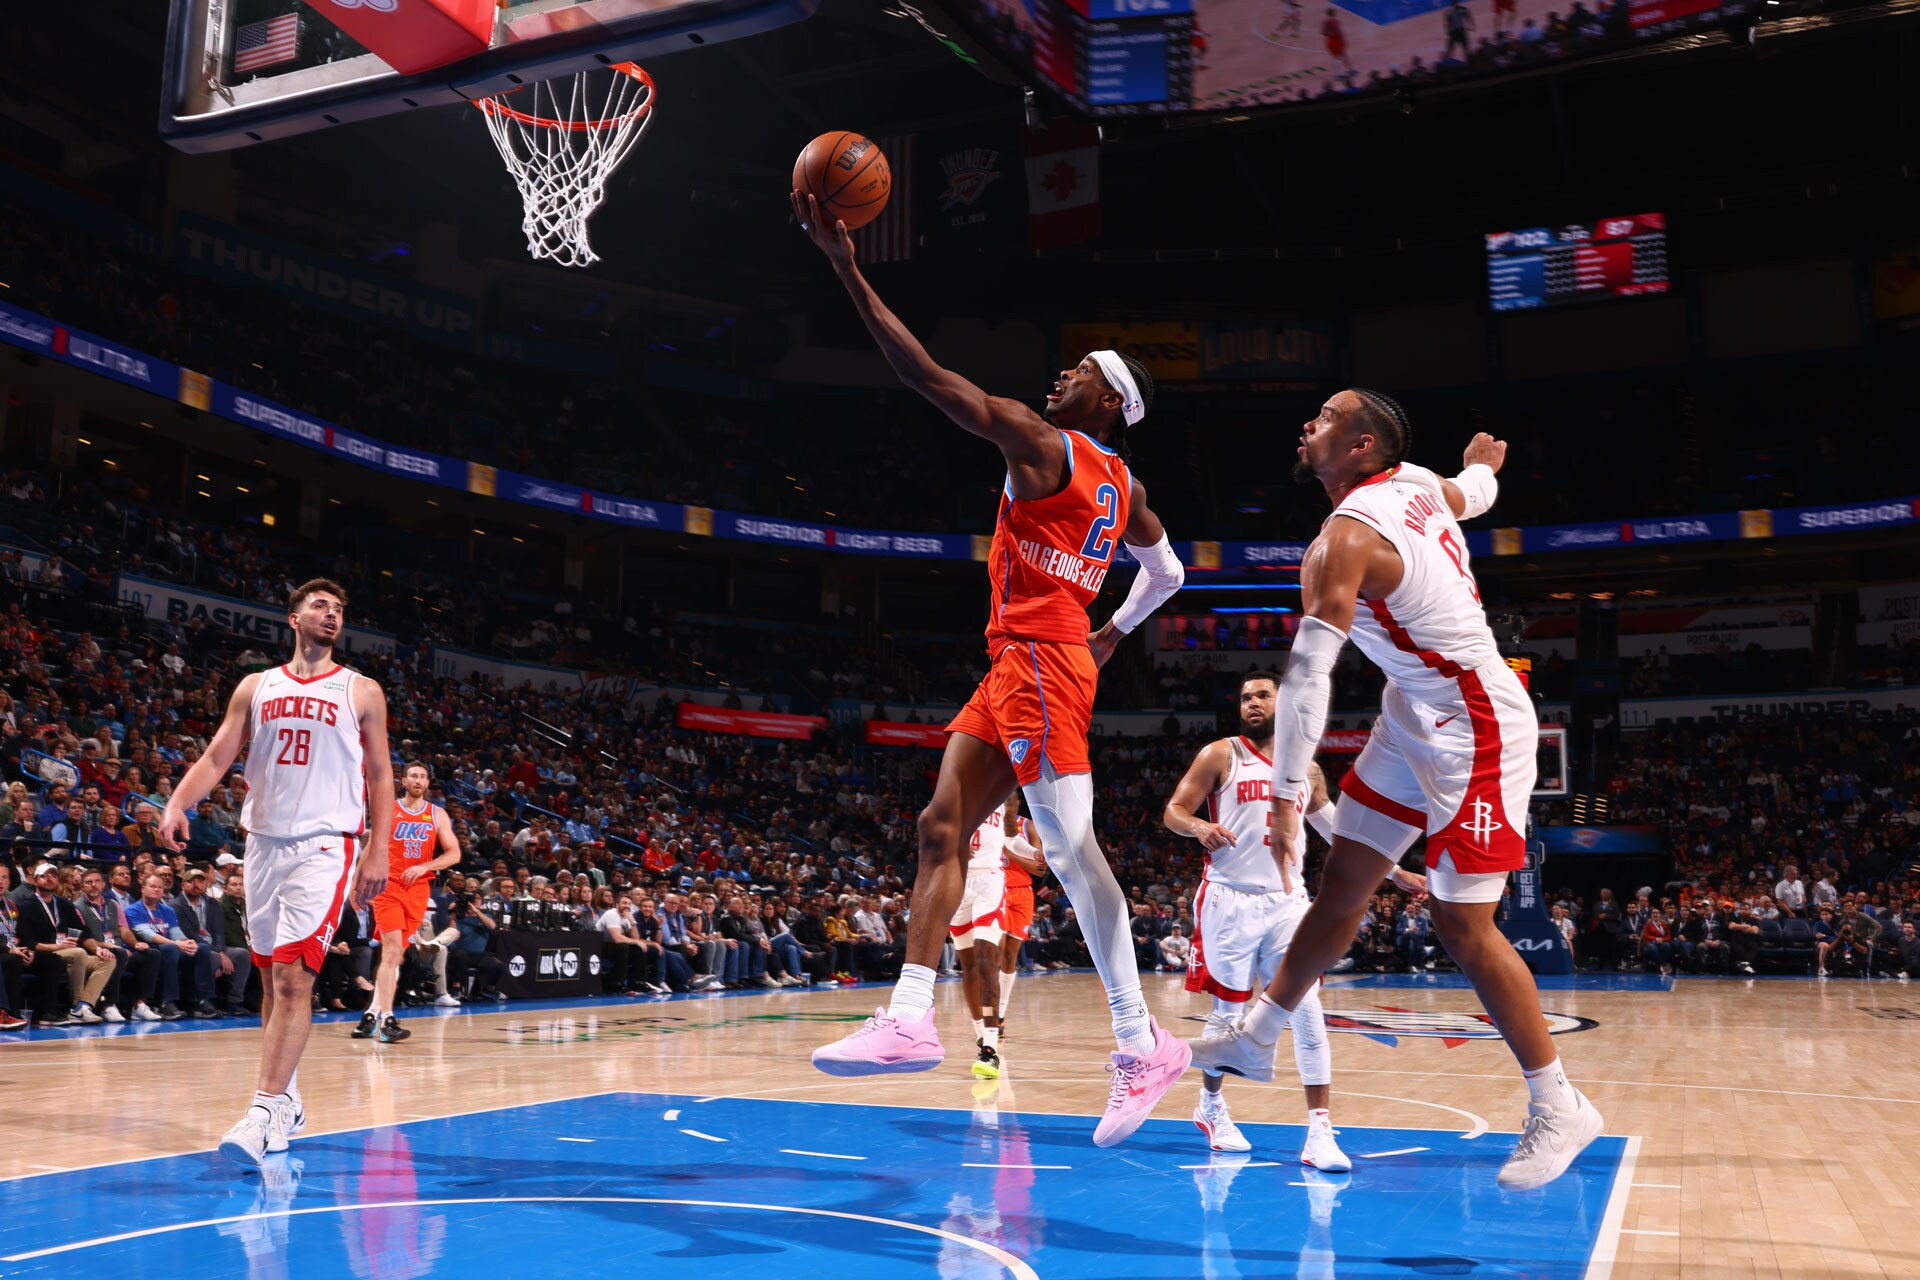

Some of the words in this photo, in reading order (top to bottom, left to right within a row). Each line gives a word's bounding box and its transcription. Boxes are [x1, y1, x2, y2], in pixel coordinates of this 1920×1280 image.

[938, 147, 999, 176] THUNDER
[180, 227, 408, 320] THUNDER
[414, 296, 473, 334] UP
[68, 334, 152, 383] ULTRA
[1275, 327, 1330, 369] CITY
[233, 396, 325, 443] SUPERIOR
[333, 431, 386, 465] LIGHT
[385, 450, 440, 478] BEER
[592, 496, 659, 523] ULTRA
[1799, 502, 1912, 529] SUPERIOR
[1079, 482, 1118, 563] 2
[1633, 519, 1711, 541] ULTRA
[735, 518, 825, 544] SUPERIOR
[835, 532, 892, 551] LIGHT
[892, 535, 943, 554] BEER
[1243, 544, 1305, 562] SUPER
[1018, 539, 1108, 593] GILGEOUS-ALE
[121, 588, 152, 614] 107
[167, 596, 364, 658] BASKETL
[1686, 634, 1709, 646] POST
[1720, 632, 1739, 643] OAK
[436, 657, 457, 677] 108
[261, 696, 339, 727] ROCKETS
[1623, 709, 1649, 725] 111
[1710, 700, 1871, 722] THUNDER
[276, 728, 311, 765] 28
[394, 820, 433, 841] OKC
[970, 829, 981, 851] 4
[403, 841, 422, 858] 33
[1519, 872, 1534, 885] GET
[1519, 885, 1535, 897] THE
[1519, 897, 1535, 909] APP
[509, 962, 527, 971] TNT
[562, 960, 578, 970] TNT
